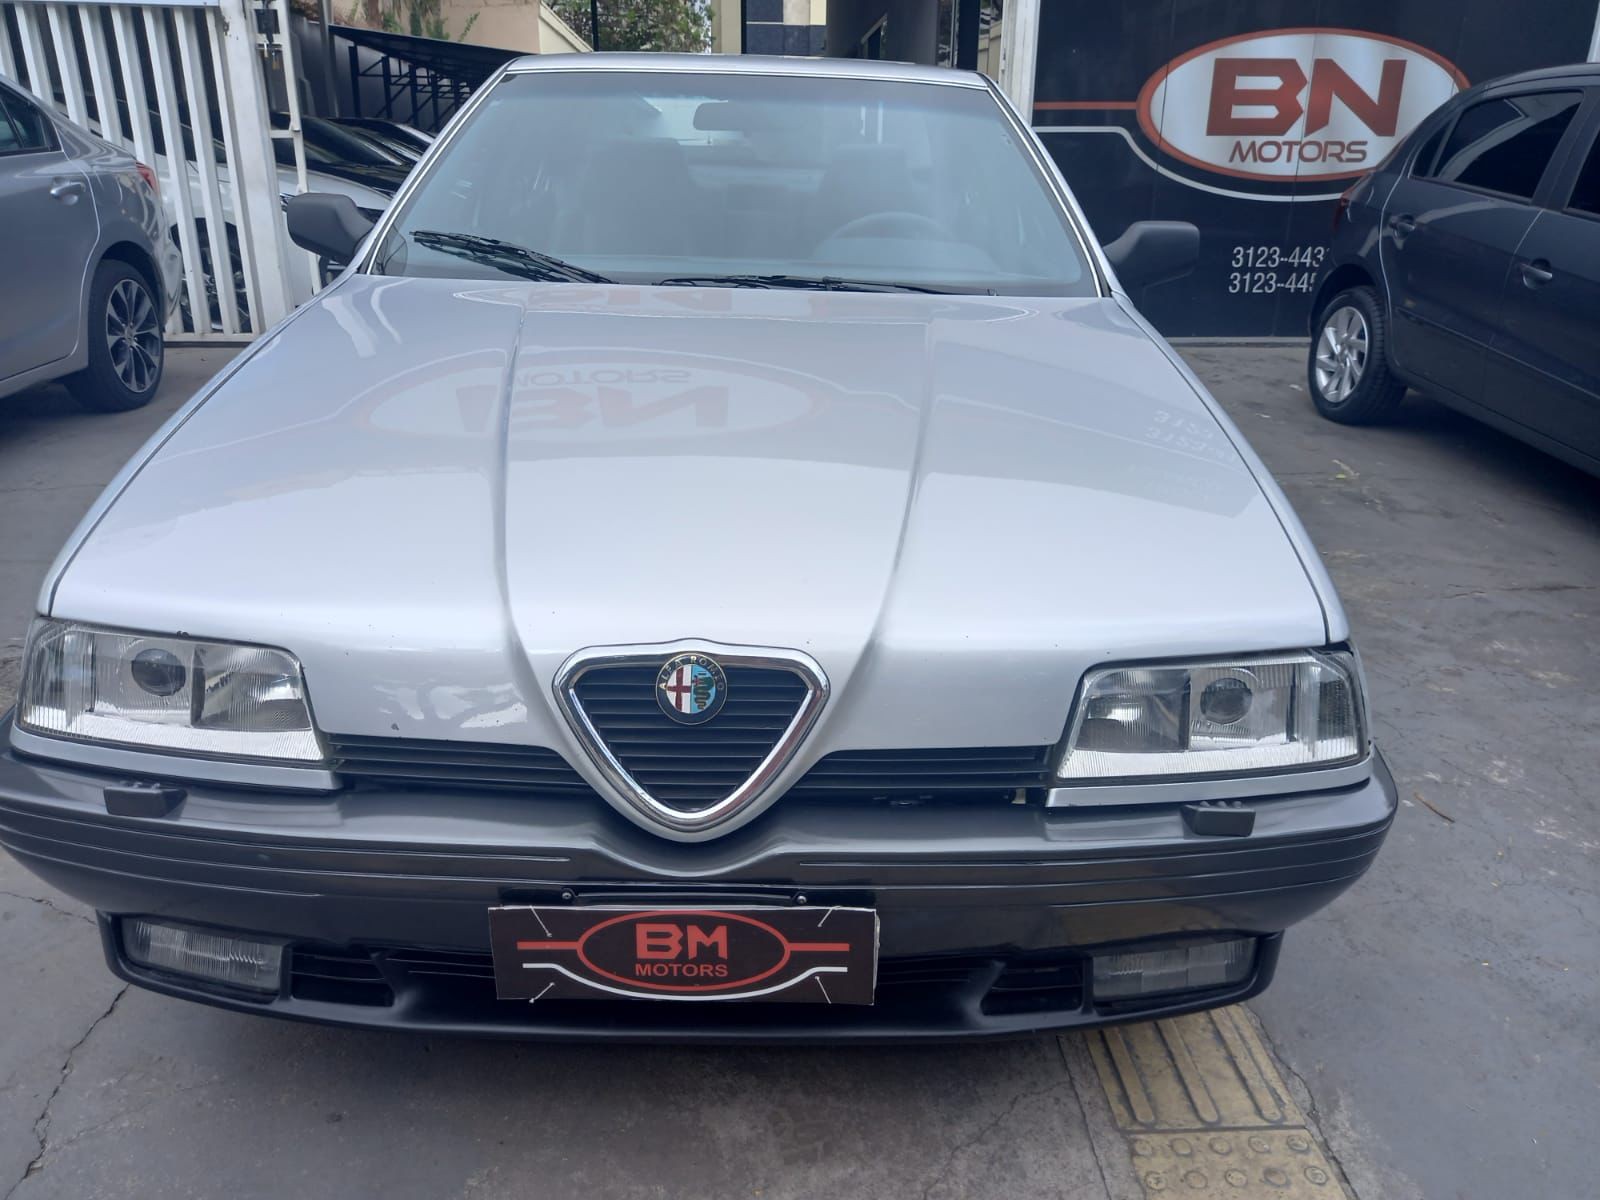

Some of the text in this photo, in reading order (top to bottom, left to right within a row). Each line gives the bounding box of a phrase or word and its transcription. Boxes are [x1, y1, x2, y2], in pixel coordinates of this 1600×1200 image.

[1206, 58, 1408, 137] BN
[1229, 140, 1368, 163] MOTORS
[1231, 246, 1330, 268] 3123-443
[636, 923, 728, 960] BM
[635, 963, 728, 977] MOTORS
